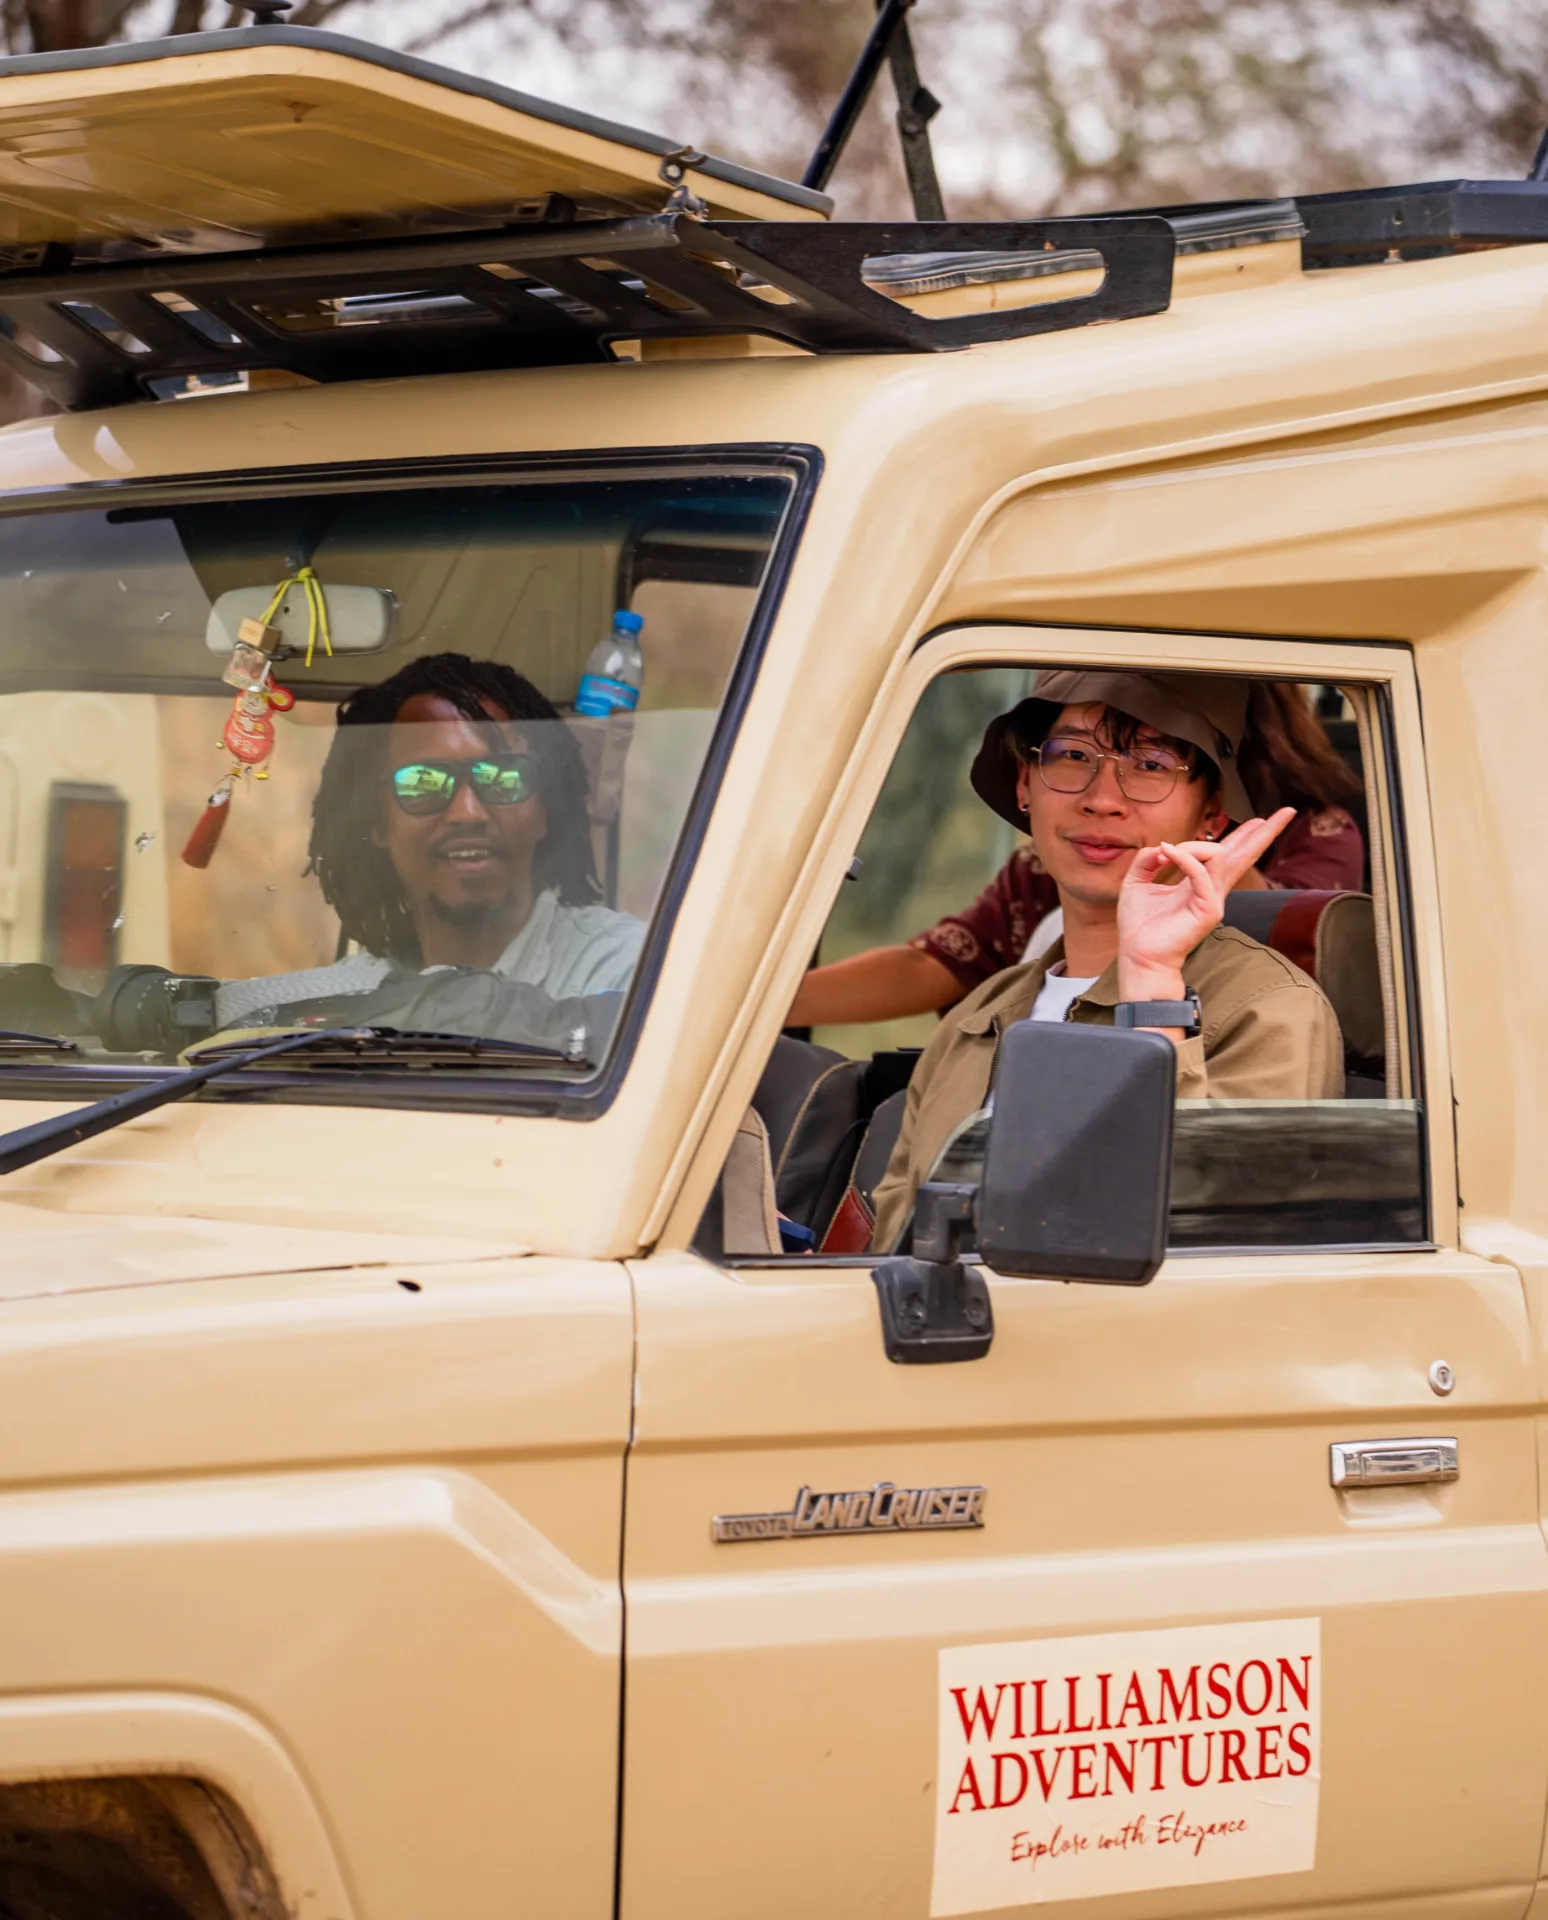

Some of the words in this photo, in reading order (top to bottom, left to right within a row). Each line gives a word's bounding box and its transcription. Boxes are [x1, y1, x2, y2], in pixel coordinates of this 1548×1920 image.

[720, 1517, 790, 1538] TOYOTA
[949, 1655, 1313, 1745] WILLIAMSON
[947, 1721, 1312, 1815] ADVENTURES
[1010, 1824, 1090, 1872] Explore
[1098, 1813, 1147, 1850] with
[1157, 1810, 1248, 1857] Elegance
